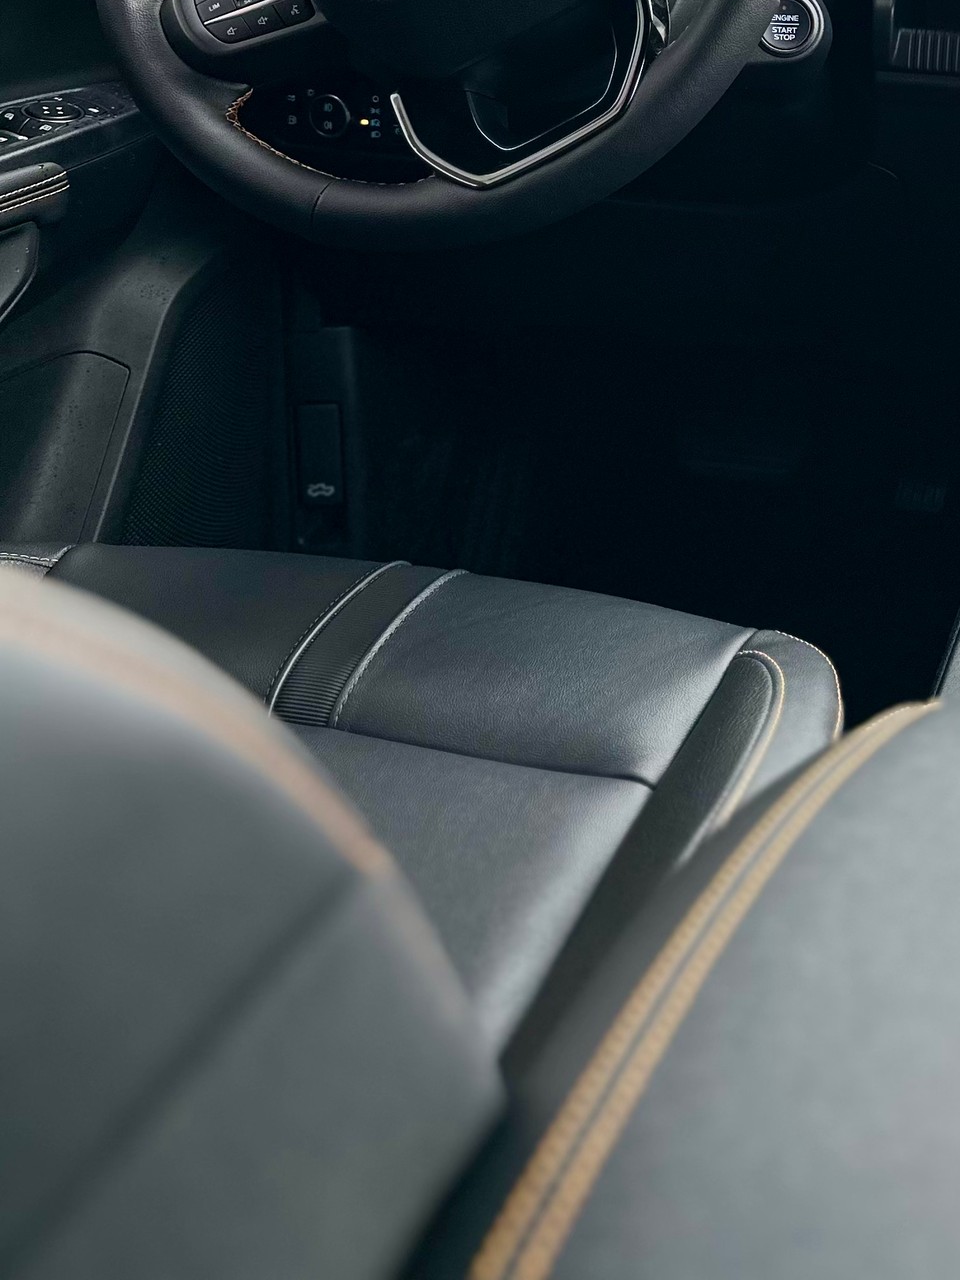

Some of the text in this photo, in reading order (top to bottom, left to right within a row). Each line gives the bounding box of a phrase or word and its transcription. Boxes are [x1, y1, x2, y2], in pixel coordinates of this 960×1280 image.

[208, 2, 220, 12] LIM
[771, 14, 799, 22] ENGINE
[771, 26, 798, 34] START
[773, 33, 796, 41] STOP
